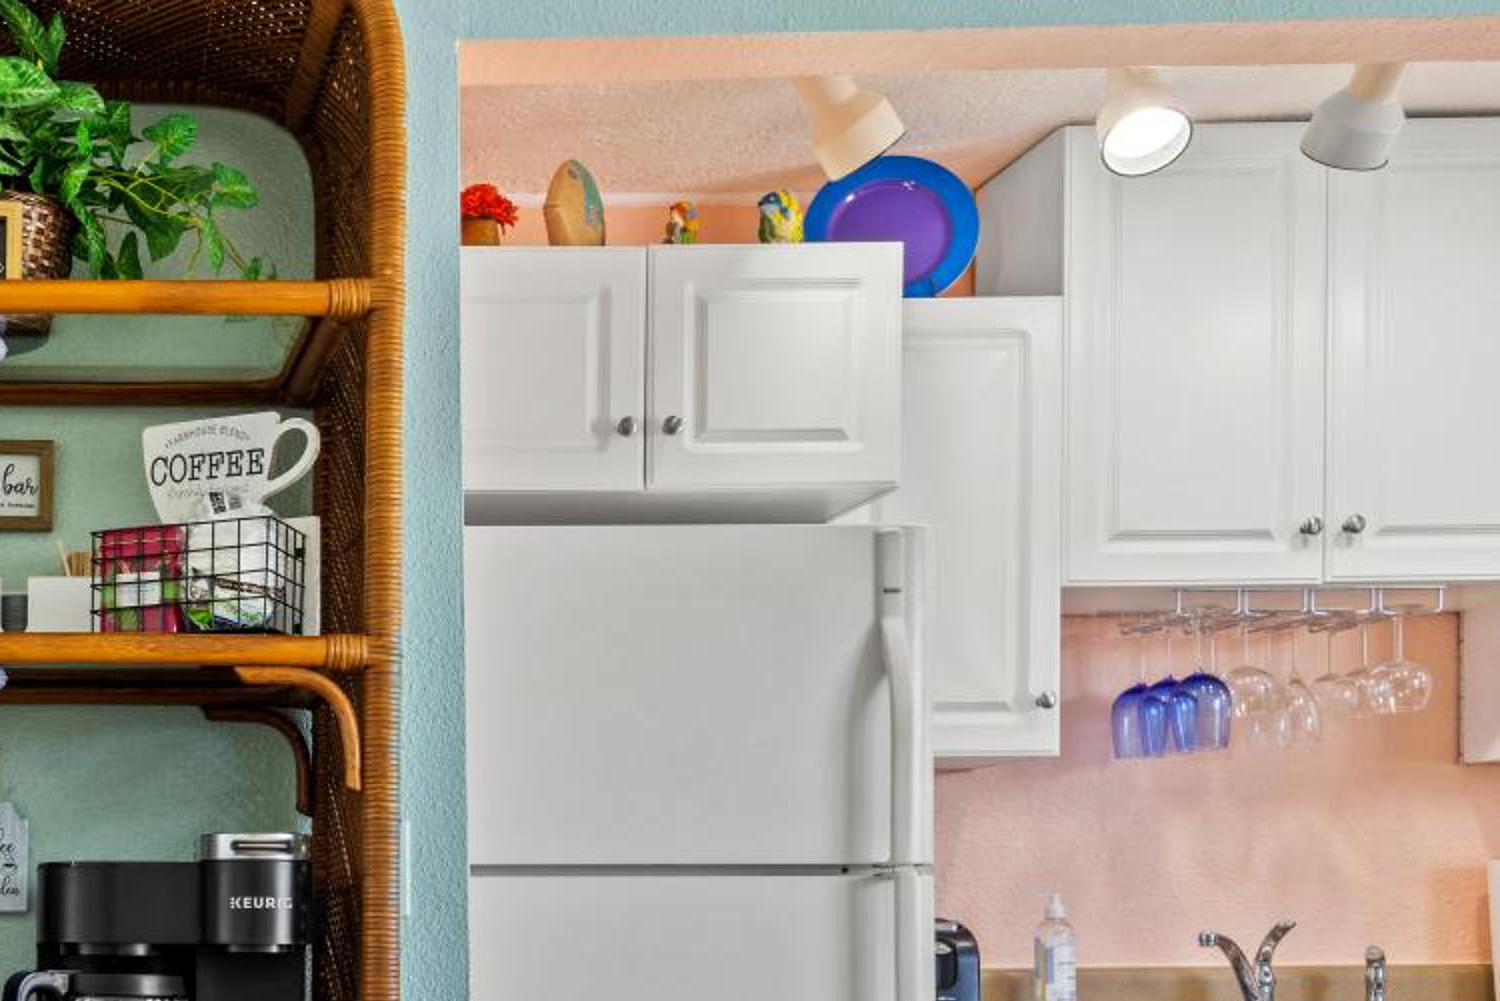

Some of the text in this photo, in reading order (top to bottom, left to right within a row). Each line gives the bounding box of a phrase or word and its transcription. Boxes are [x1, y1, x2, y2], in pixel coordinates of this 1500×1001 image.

[3, 463, 40, 495] bar
[151, 448, 265, 486] COFFEE
[229, 896, 293, 909] KEURIG
